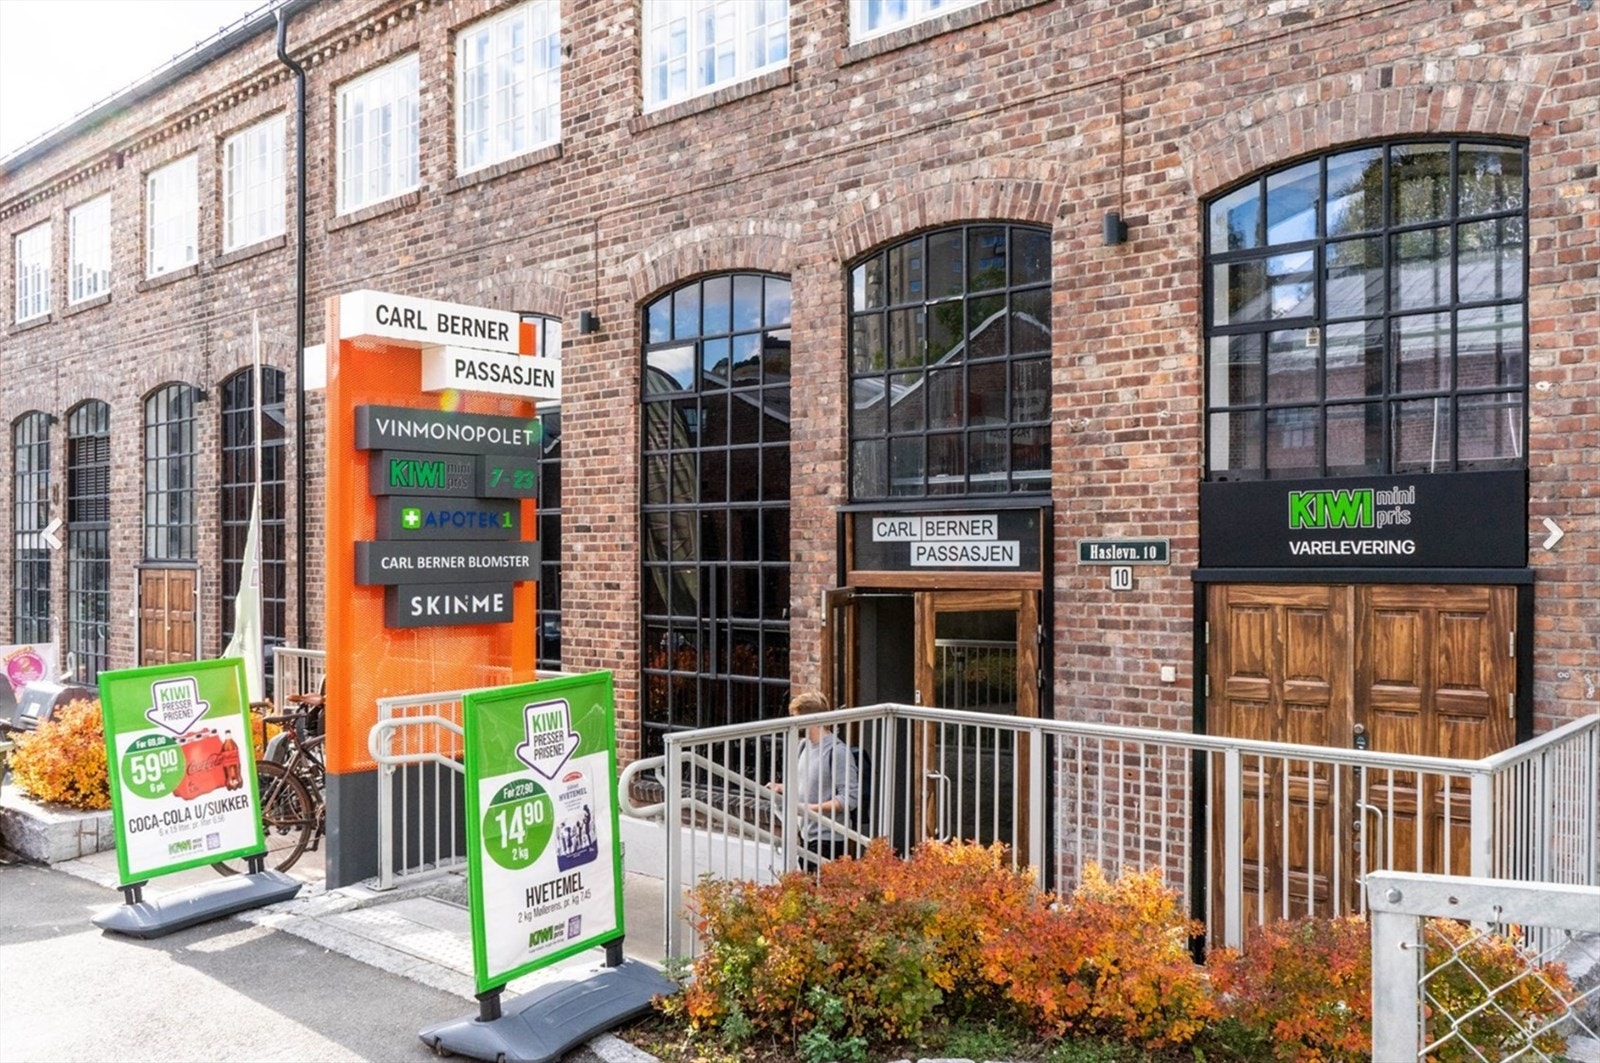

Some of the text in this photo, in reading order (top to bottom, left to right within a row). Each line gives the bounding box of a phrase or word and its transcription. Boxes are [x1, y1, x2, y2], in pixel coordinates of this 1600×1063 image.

[376, 304, 509, 342] CARL BERNER
[455, 359, 555, 388] PASSASJEN
[376, 418, 533, 446] VINMONOPOLET
[390, 458, 446, 488] KIWI
[447, 462, 471, 475] mini
[1377, 485, 1415, 505] mini
[1289, 488, 1374, 529] KIWI
[1377, 507, 1411, 529] pris
[877, 519, 994, 537] CARL BERNER
[916, 546, 1013, 562] PASSASJEN
[1090, 544, 1157, 560] Haslevn. 10
[1289, 540, 1415, 555] VARELEVERING
[381, 555, 530, 569] CARL BERNER BLOMSTER
[1115, 568, 1129, 587] 10
[160, 685, 191, 702] KIWI
[162, 700, 193, 712] PRESSER
[163, 710, 194, 721] PRISENE!
[532, 710, 563, 733] KIWI
[533, 730, 564, 748] PRESSER
[533, 744, 565, 761] PRISENE!
[129, 794, 249, 834] COCA-COLA U/SUKKER
[168, 839, 191, 855] KIWI
[512, 847, 529, 861] 2 kg
[526, 872, 584, 908] HVETEMEL
[518, 912, 523, 923] 2
[523, 911, 532, 922] kg
[571, 895, 579, 905] kg
[528, 925, 554, 948] KIWI
